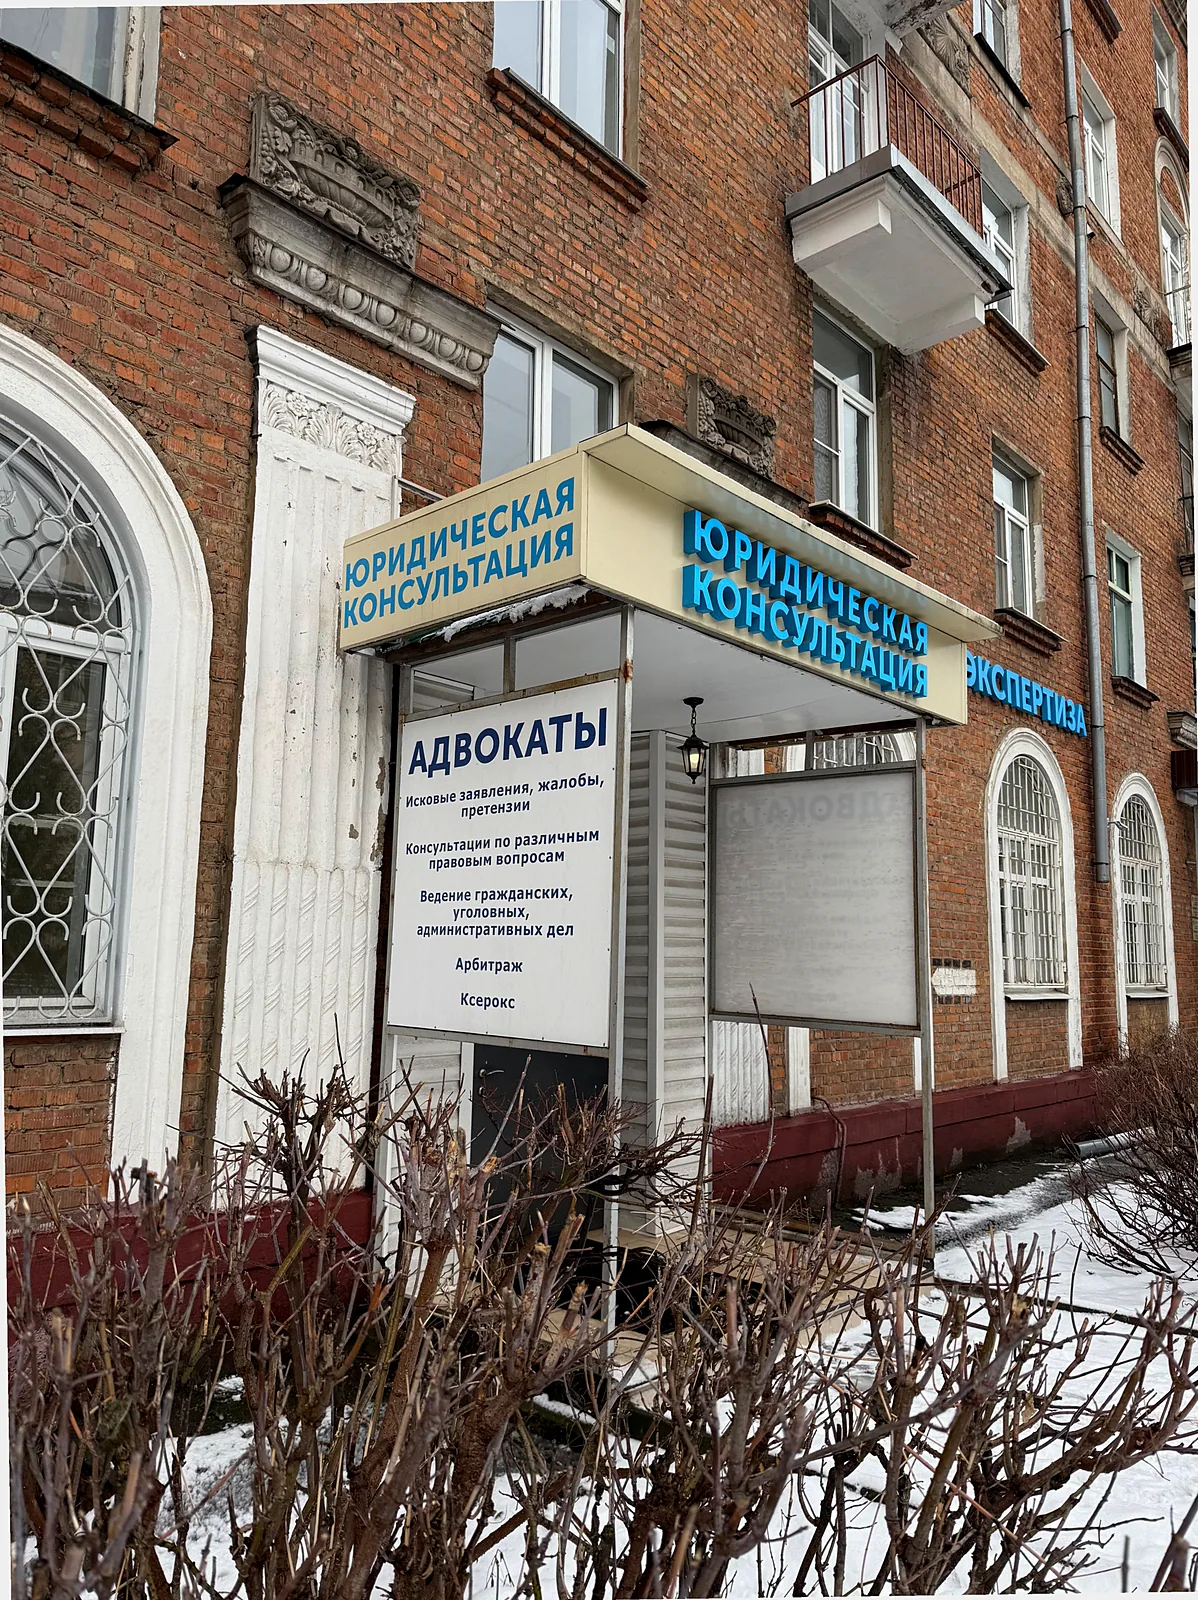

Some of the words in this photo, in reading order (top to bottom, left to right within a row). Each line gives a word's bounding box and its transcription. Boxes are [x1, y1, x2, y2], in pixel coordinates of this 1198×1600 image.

[345, 477, 575, 591] ЮРИДИЧЕСКАЯ
[344, 522, 574, 629] КОНСУЛЬТАЦИЯ
[683, 509, 928, 656] ЮРИДИЧЕСКАЯ
[682, 563, 928, 698] КОНСУЛЬТАЦИЯ
[966, 650, 1088, 737] ЭКСПЕРТИЗА
[408, 707, 608, 778] АДВОКАТЫ
[405, 793, 457, 808] Исковые
[459, 782, 534, 801] заявления,
[538, 772, 605, 793] жалобы,
[461, 800, 530, 819] претензии
[405, 838, 491, 856] Консультации
[494, 836, 511, 849] по
[514, 829, 600, 849] различным
[429, 853, 492, 872] правовым
[496, 850, 565, 868] вопросам
[420, 890, 472, 904] Ведение
[475, 887, 574, 904] гражданских,
[453, 906, 530, 922] уголовных,
[416, 924, 543, 940] административных
[546, 924, 574, 939] дел
[455, 957, 524, 975] Арбитраж
[460, 992, 516, 1010] Ксерокс
